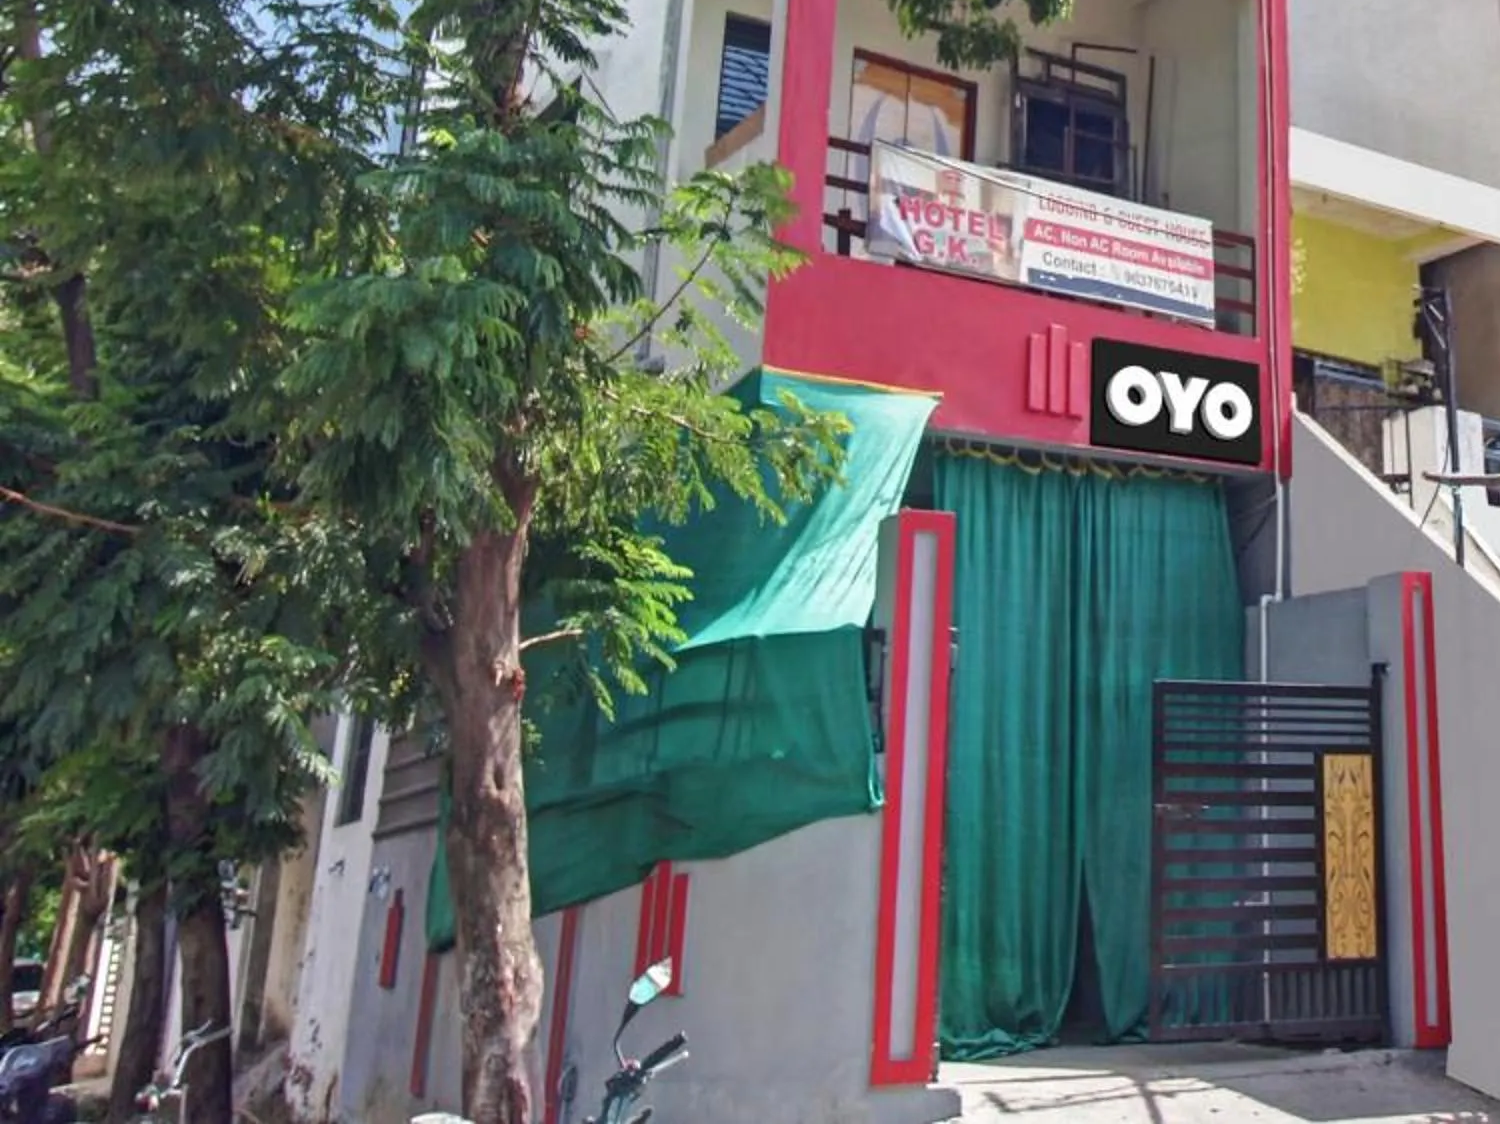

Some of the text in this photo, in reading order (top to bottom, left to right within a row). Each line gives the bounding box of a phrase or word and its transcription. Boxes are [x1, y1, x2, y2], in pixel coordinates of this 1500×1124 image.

[899, 196, 1004, 242] HOTEL
[1042, 251, 1097, 276] Contact
[1061, 231, 1088, 247] Non
[1089, 236, 1110, 253] AC
[1111, 242, 1150, 262] Room
[1105, 365, 1253, 440] OYO
